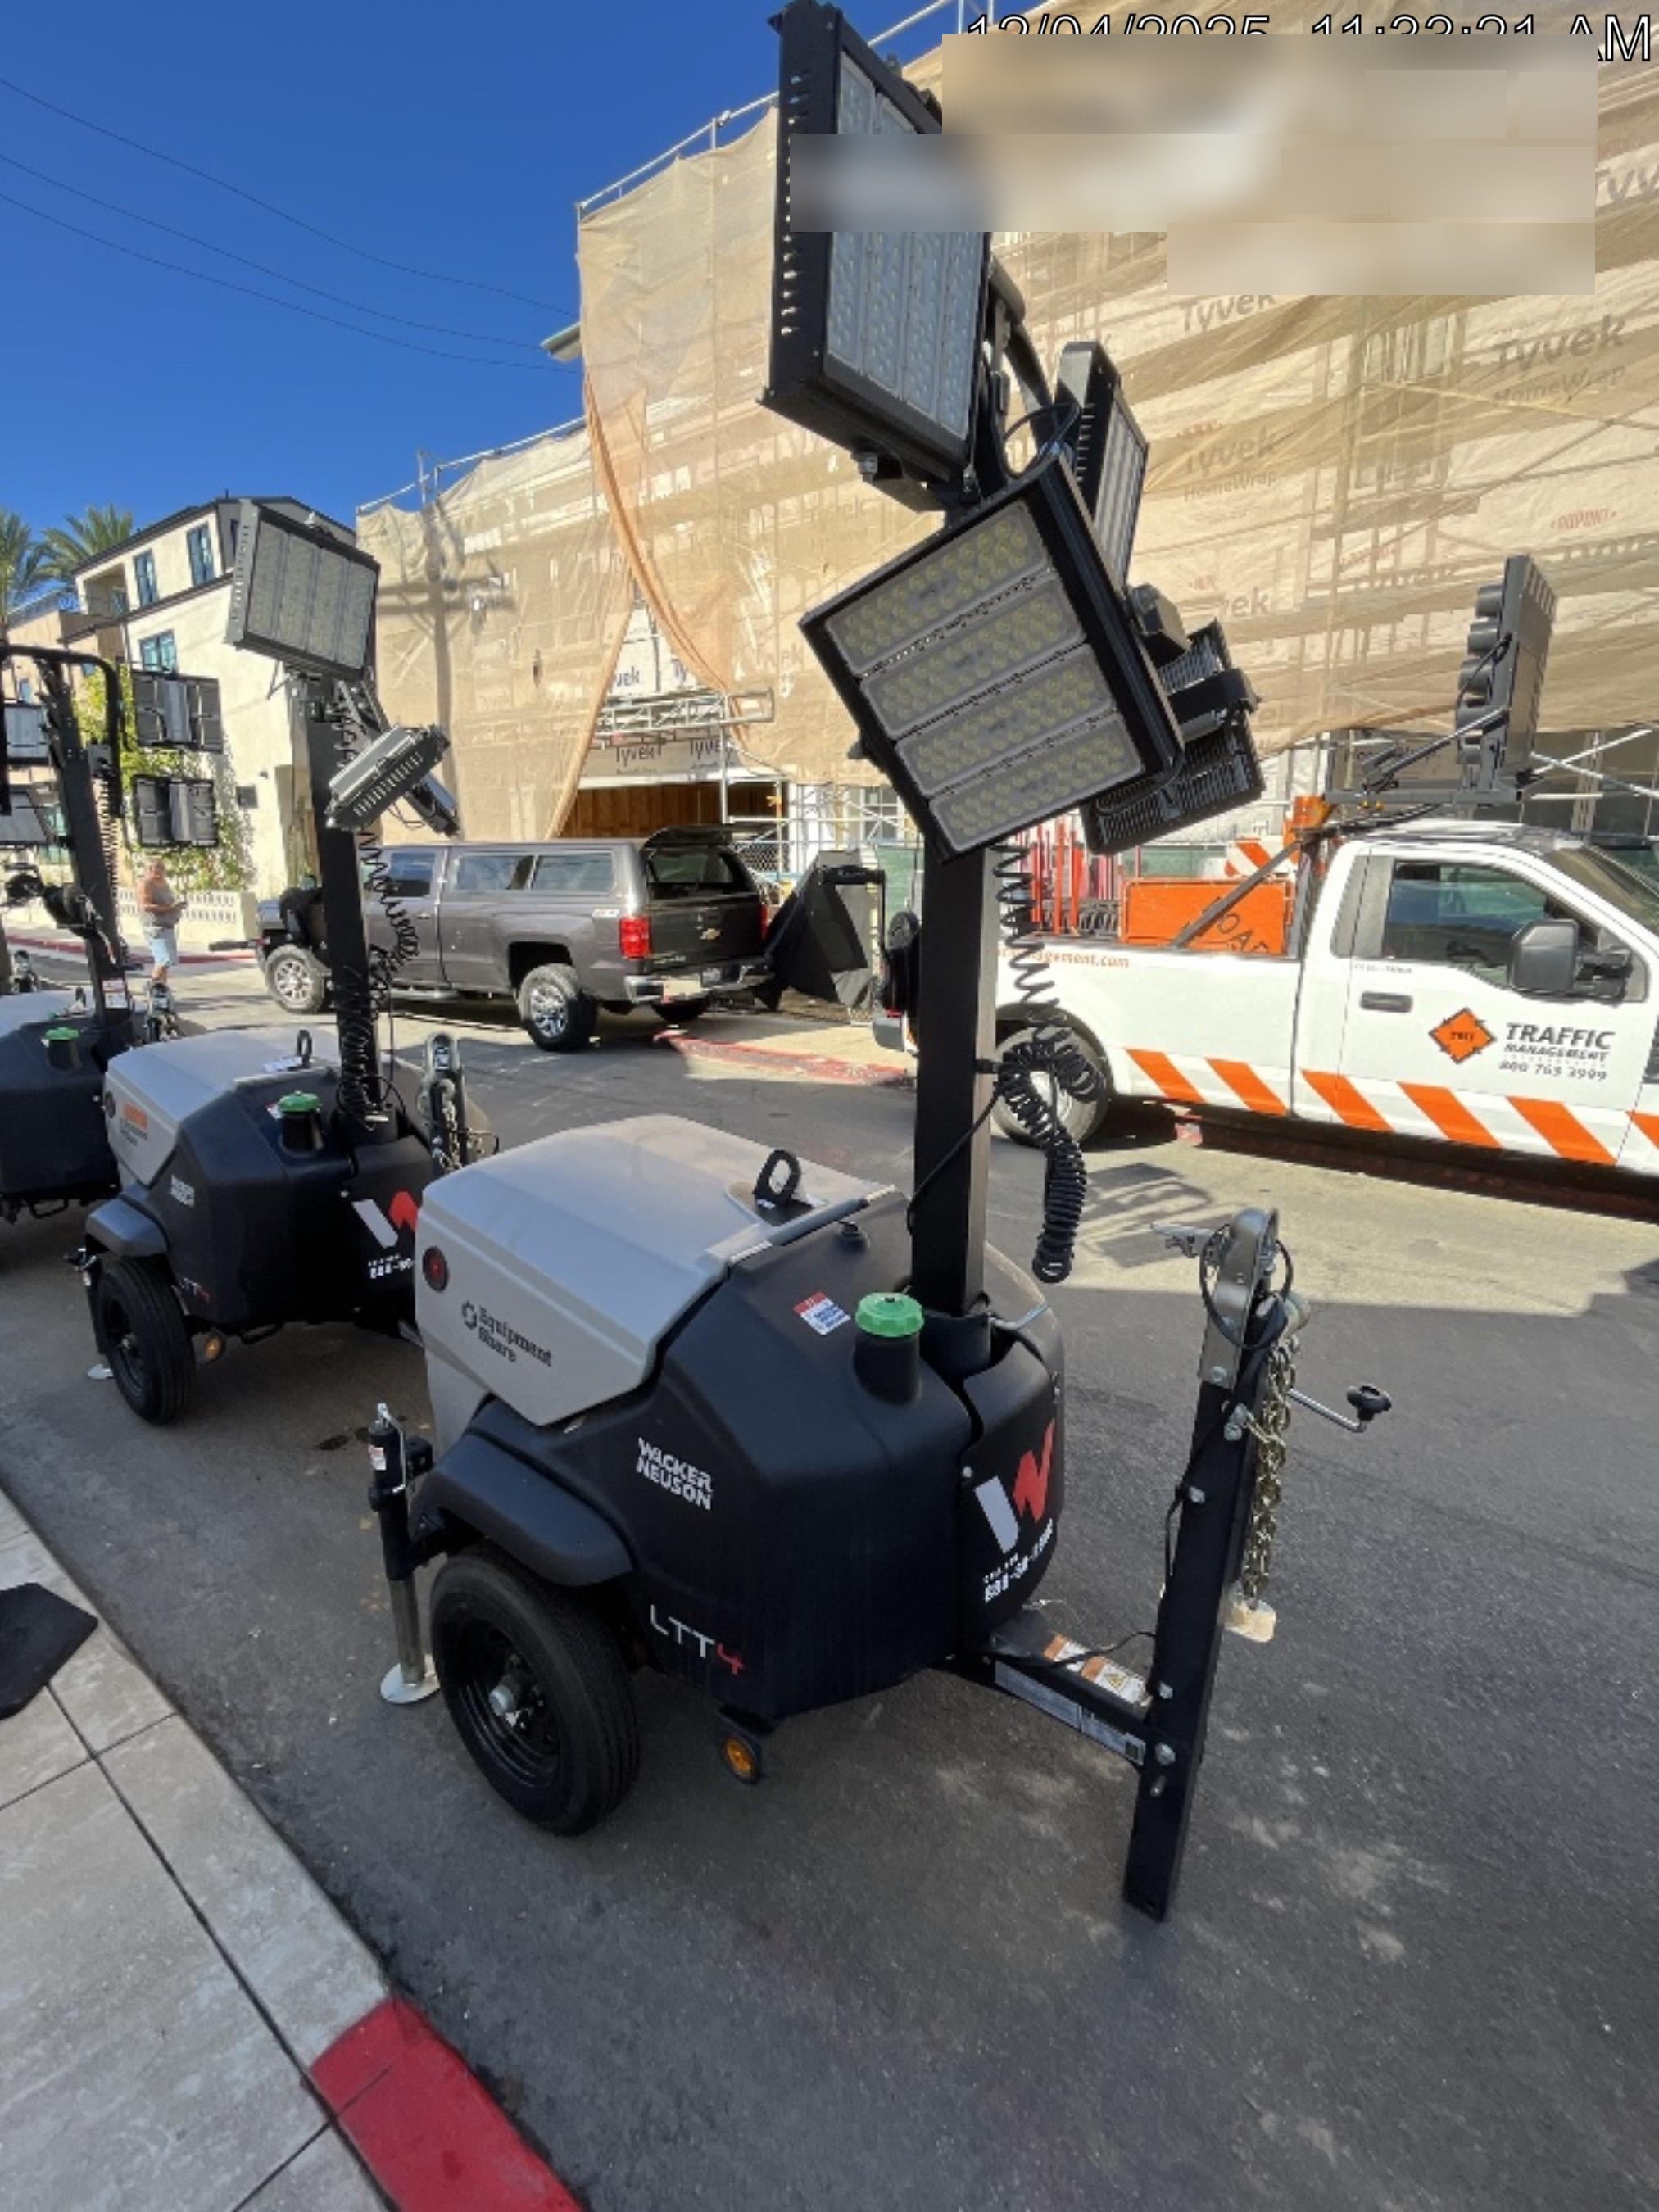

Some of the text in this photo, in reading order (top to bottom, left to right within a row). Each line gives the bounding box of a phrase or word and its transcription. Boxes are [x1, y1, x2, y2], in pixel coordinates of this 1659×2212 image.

[1492, 315, 1625, 371] Tyvek
[1504, 1043, 1610, 1063] MANAGEMENT
[1506, 1022, 1616, 1049] TRAFFIC
[478, 1304, 551, 1367] Equipment
[478, 1326, 517, 1362] Share
[636, 1456, 711, 1510] NEUSON
[638, 1437, 714, 1493] WACKER
[650, 1604, 745, 1675] LTT4
